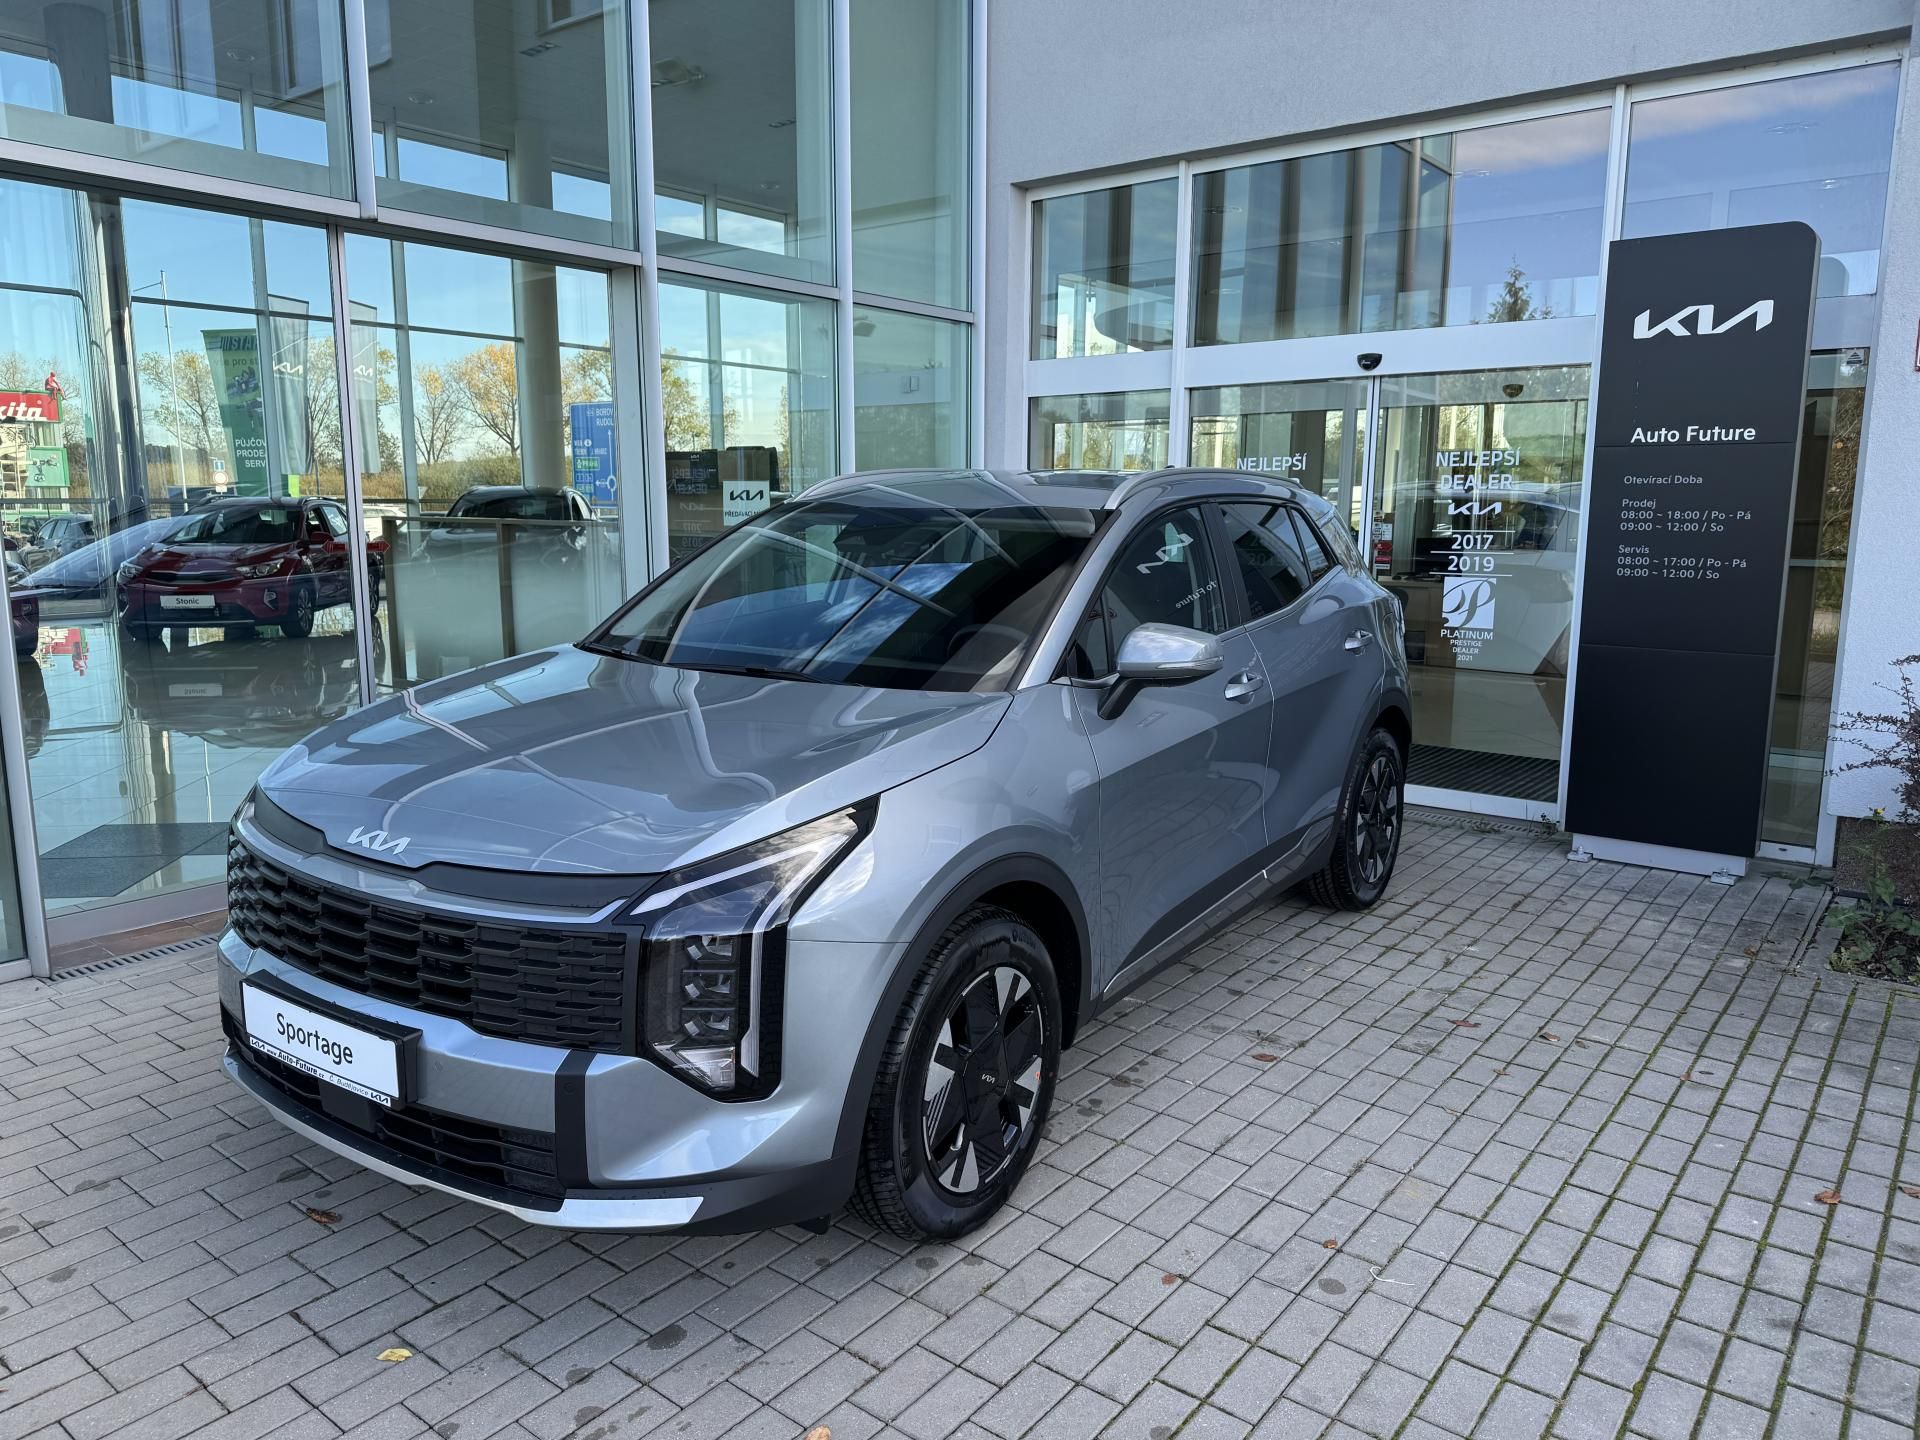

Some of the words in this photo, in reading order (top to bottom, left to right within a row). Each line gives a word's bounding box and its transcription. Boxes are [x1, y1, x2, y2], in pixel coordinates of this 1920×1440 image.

[1633, 299, 1774, 339] KIA
[1630, 427, 1680, 443] Auto
[1686, 425, 1756, 442] Future
[236, 449, 266, 457] PRODE
[1236, 452, 1308, 471] NEJLEPŠÍ
[1440, 474, 1513, 489] DEALER
[1623, 474, 1673, 485] Otevírací
[1674, 474, 1703, 484] Doba
[729, 489, 764, 501] KIA
[1448, 501, 1502, 515] KIA
[1622, 498, 1656, 509] Prodej
[1621, 510, 1653, 519] 08:00
[1667, 510, 1700, 519] 18:00
[1711, 510, 1726, 520] Po
[1736, 510, 1751, 520] Pá
[1620, 522, 1653, 531] 09:00
[1666, 522, 1699, 531] 12:00
[1709, 522, 1724, 532] So
[1451, 534, 1494, 550] 2017
[1618, 544, 1649, 554] Servis
[1447, 555, 1495, 571] 2019
[1617, 556, 1650, 565] 08:00
[1663, 557, 1696, 567] 17:00
[1707, 558, 1721, 567] Po
[1732, 558, 1747, 568] Pá
[1616, 568, 1649, 577] 09:00
[1662, 569, 1694, 578] 12:00
[1705, 570, 1720, 579] So
[175, 597, 199, 605] Stonic
[1440, 629, 1494, 640] PLATINUM
[1450, 639, 1483, 647] PRESTIGE
[1452, 646, 1479, 654] DEALER
[346, 825, 411, 855] KIA
[276, 1013, 354, 1065] Sportage
[251, 1039, 266, 1050] KIA
[370, 1092, 389, 1104] KIA
